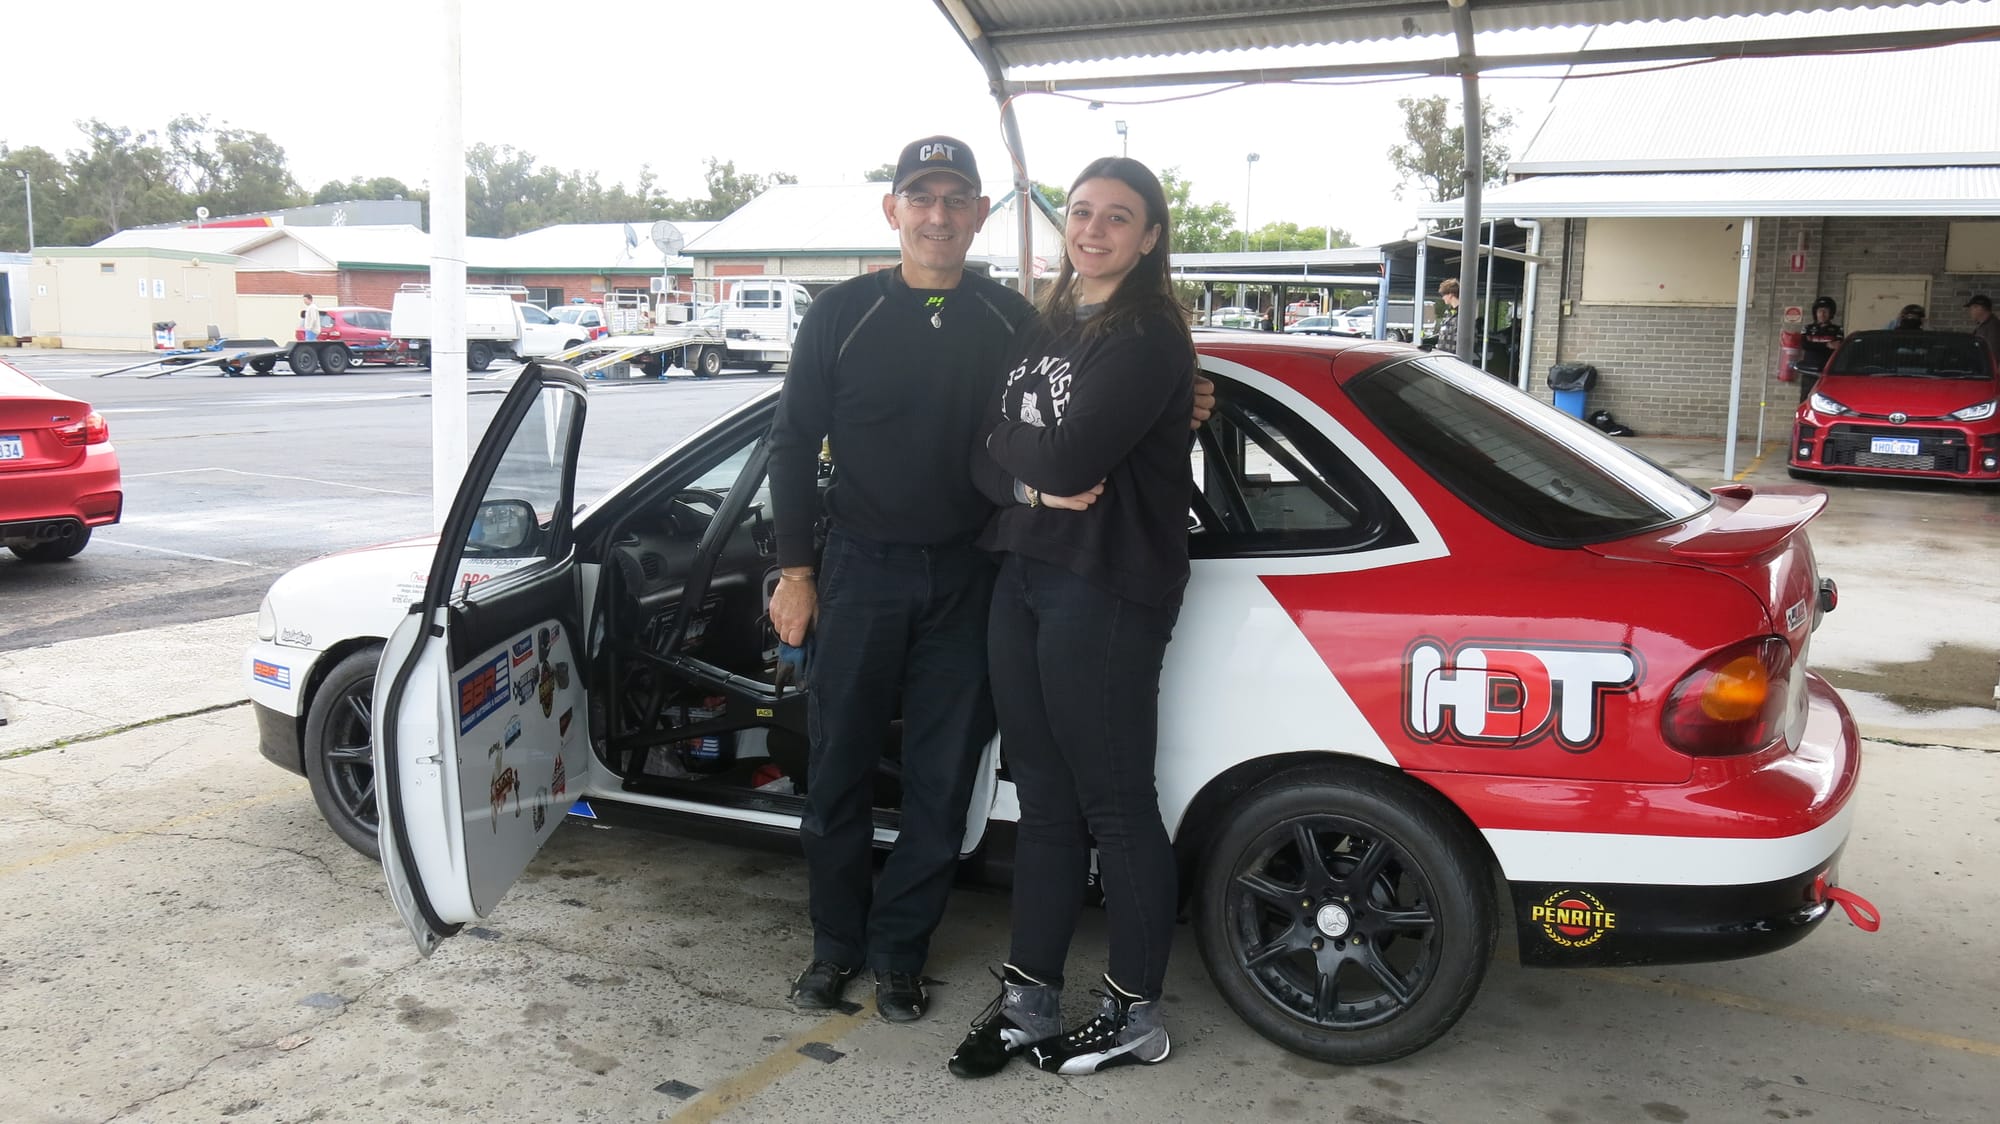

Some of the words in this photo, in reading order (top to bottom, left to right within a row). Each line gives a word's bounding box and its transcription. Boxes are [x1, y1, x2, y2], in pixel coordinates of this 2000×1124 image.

[919, 143, 958, 162] CAT
[1408, 642, 1638, 745] HDT
[1531, 905, 1616, 930] PENRITE
